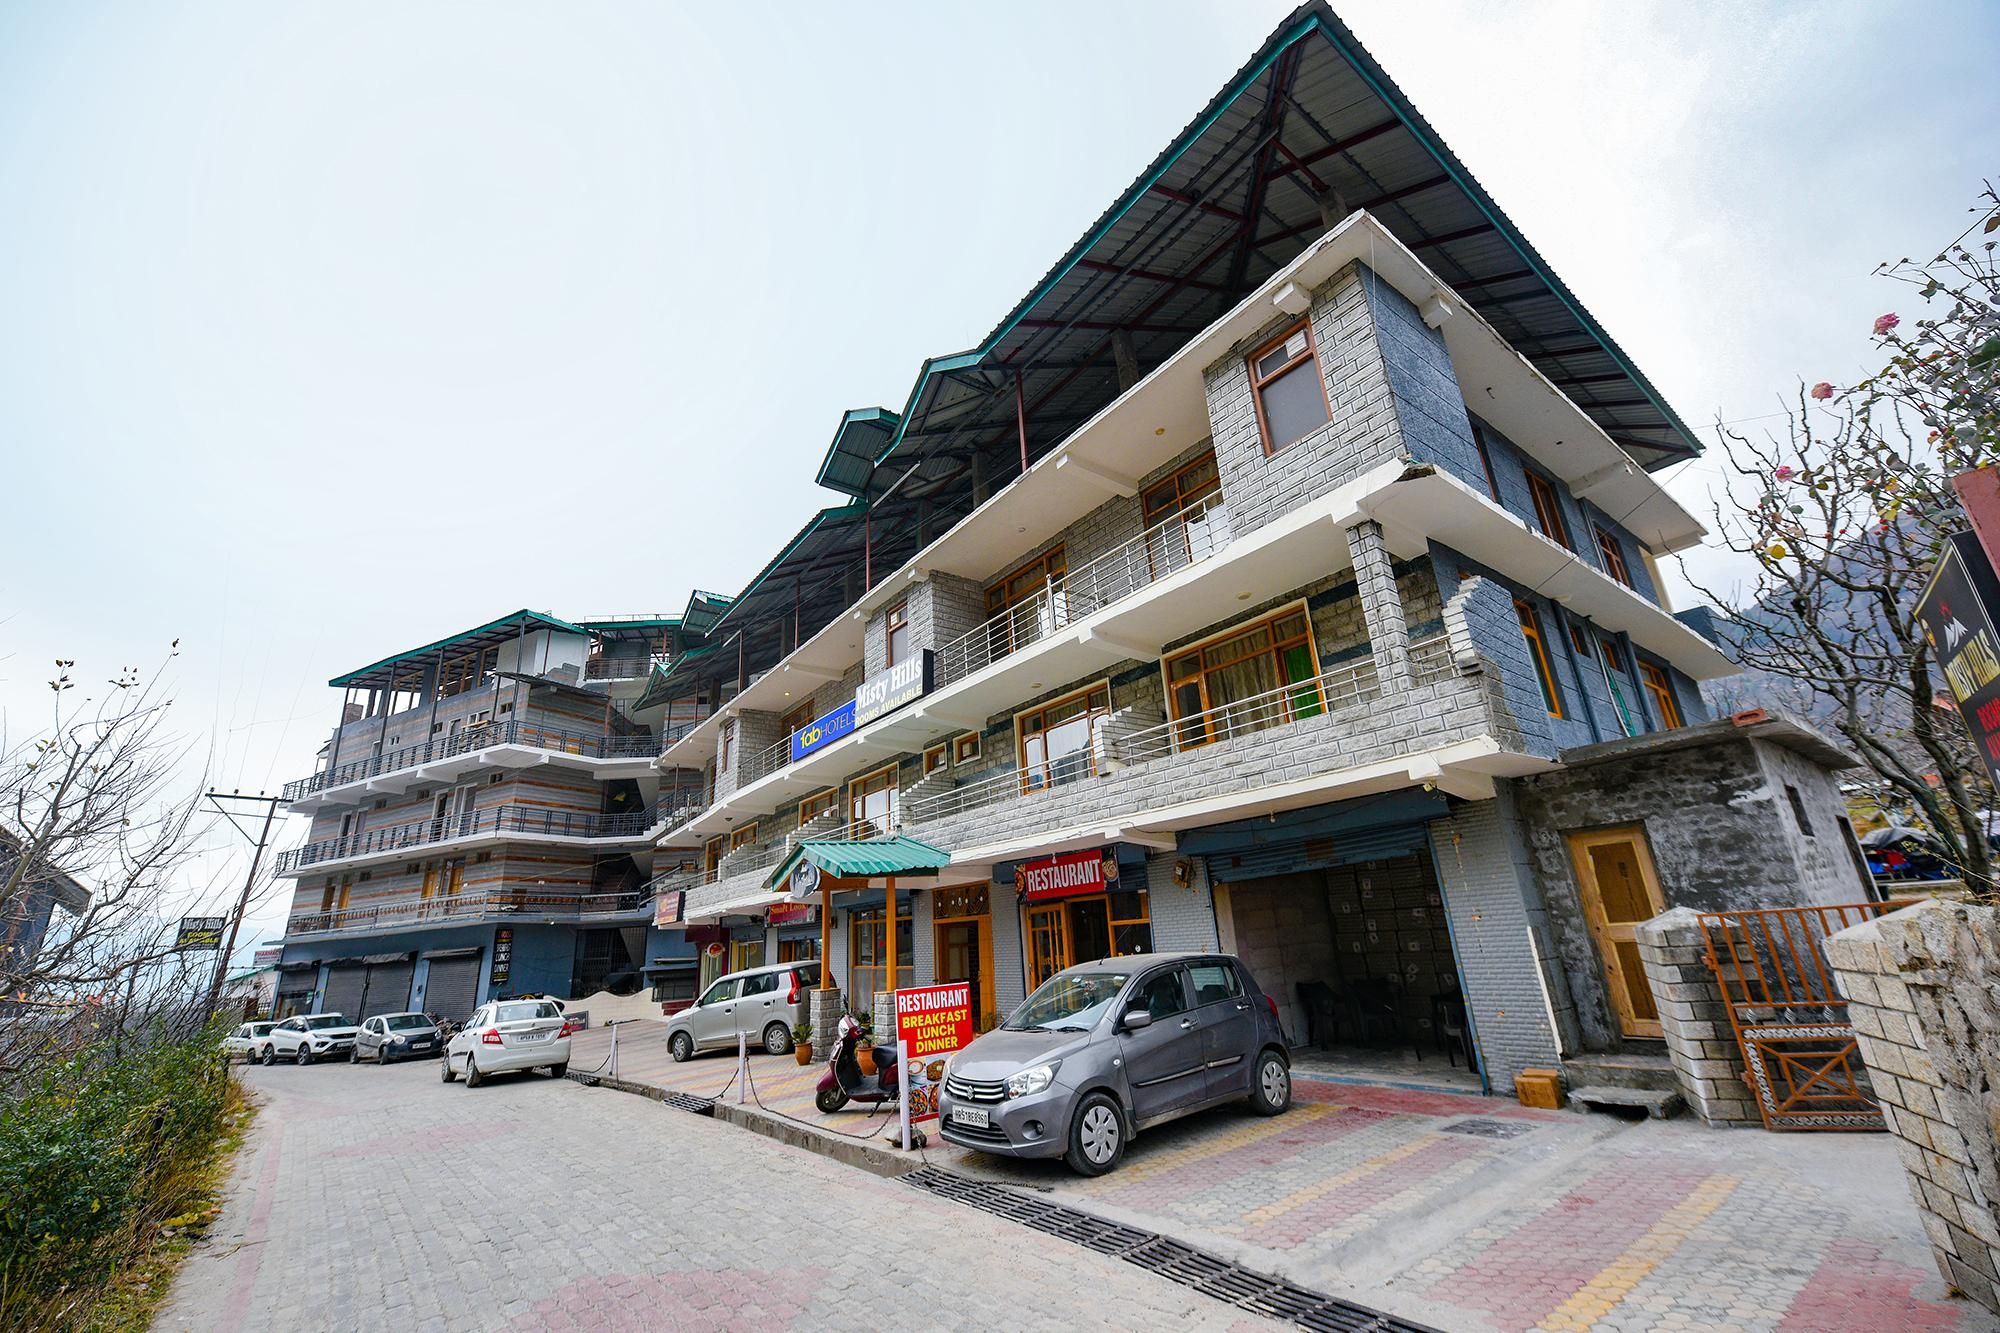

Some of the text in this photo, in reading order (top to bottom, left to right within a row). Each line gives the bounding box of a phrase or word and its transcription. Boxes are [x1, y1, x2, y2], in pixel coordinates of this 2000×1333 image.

[856, 656, 922, 709] Misty Hills
[855, 684, 922, 728] ROOMS AVAILABLE
[1027, 859, 1100, 892] RESTAURANT
[898, 988, 968, 1013] RESTAURANT
[902, 1009, 968, 1029] BREAKFAST
[917, 1023, 956, 1040] LUNCH
[916, 1036, 958, 1054] DINNER
